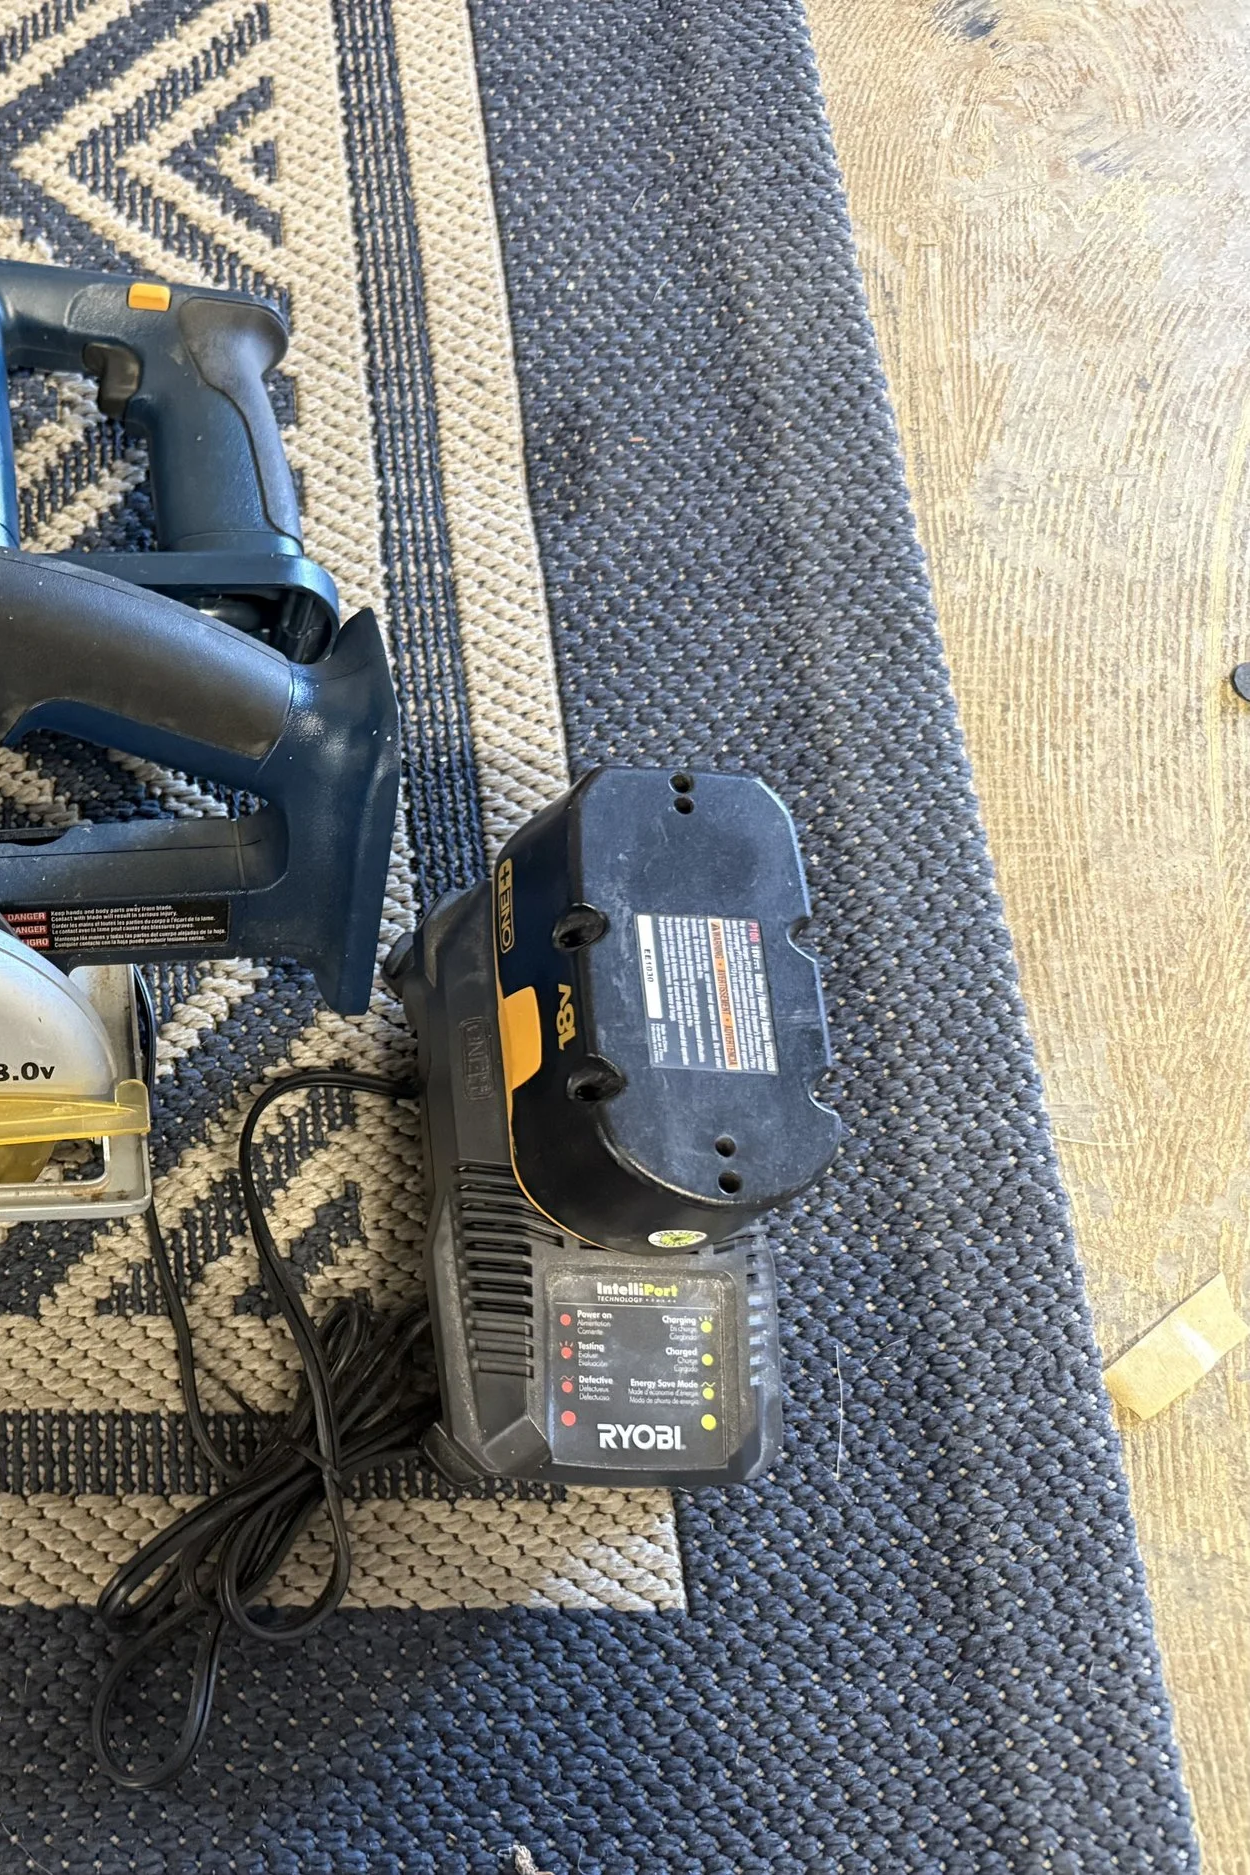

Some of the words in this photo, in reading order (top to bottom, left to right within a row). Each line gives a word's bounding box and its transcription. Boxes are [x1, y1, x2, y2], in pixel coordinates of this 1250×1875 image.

[8, 912, 45, 921] DANGER
[15, 926, 47, 934] ANGER
[748, 922, 759, 943] P100
[712, 931, 724, 959] WARNING
[644, 948, 654, 983] EE1030
[716, 969, 731, 1015] AVERTISSEMENT
[556, 984, 576, 1050] 18V
[724, 1025, 738, 1066] ADVERTENCIA
[596, 1282, 678, 1297] IntelliPort
[577, 1310, 600, 1318] Power
[662, 1315, 696, 1326] Charging
[578, 1342, 605, 1352] Testing
[666, 1347, 698, 1357] Charged
[579, 1375, 614, 1384] Defective
[630, 1378, 656, 1389] Energy
[657, 1379, 675, 1388] Save
[677, 1380, 698, 1388] Mode
[597, 1424, 682, 1450] RYOBI
